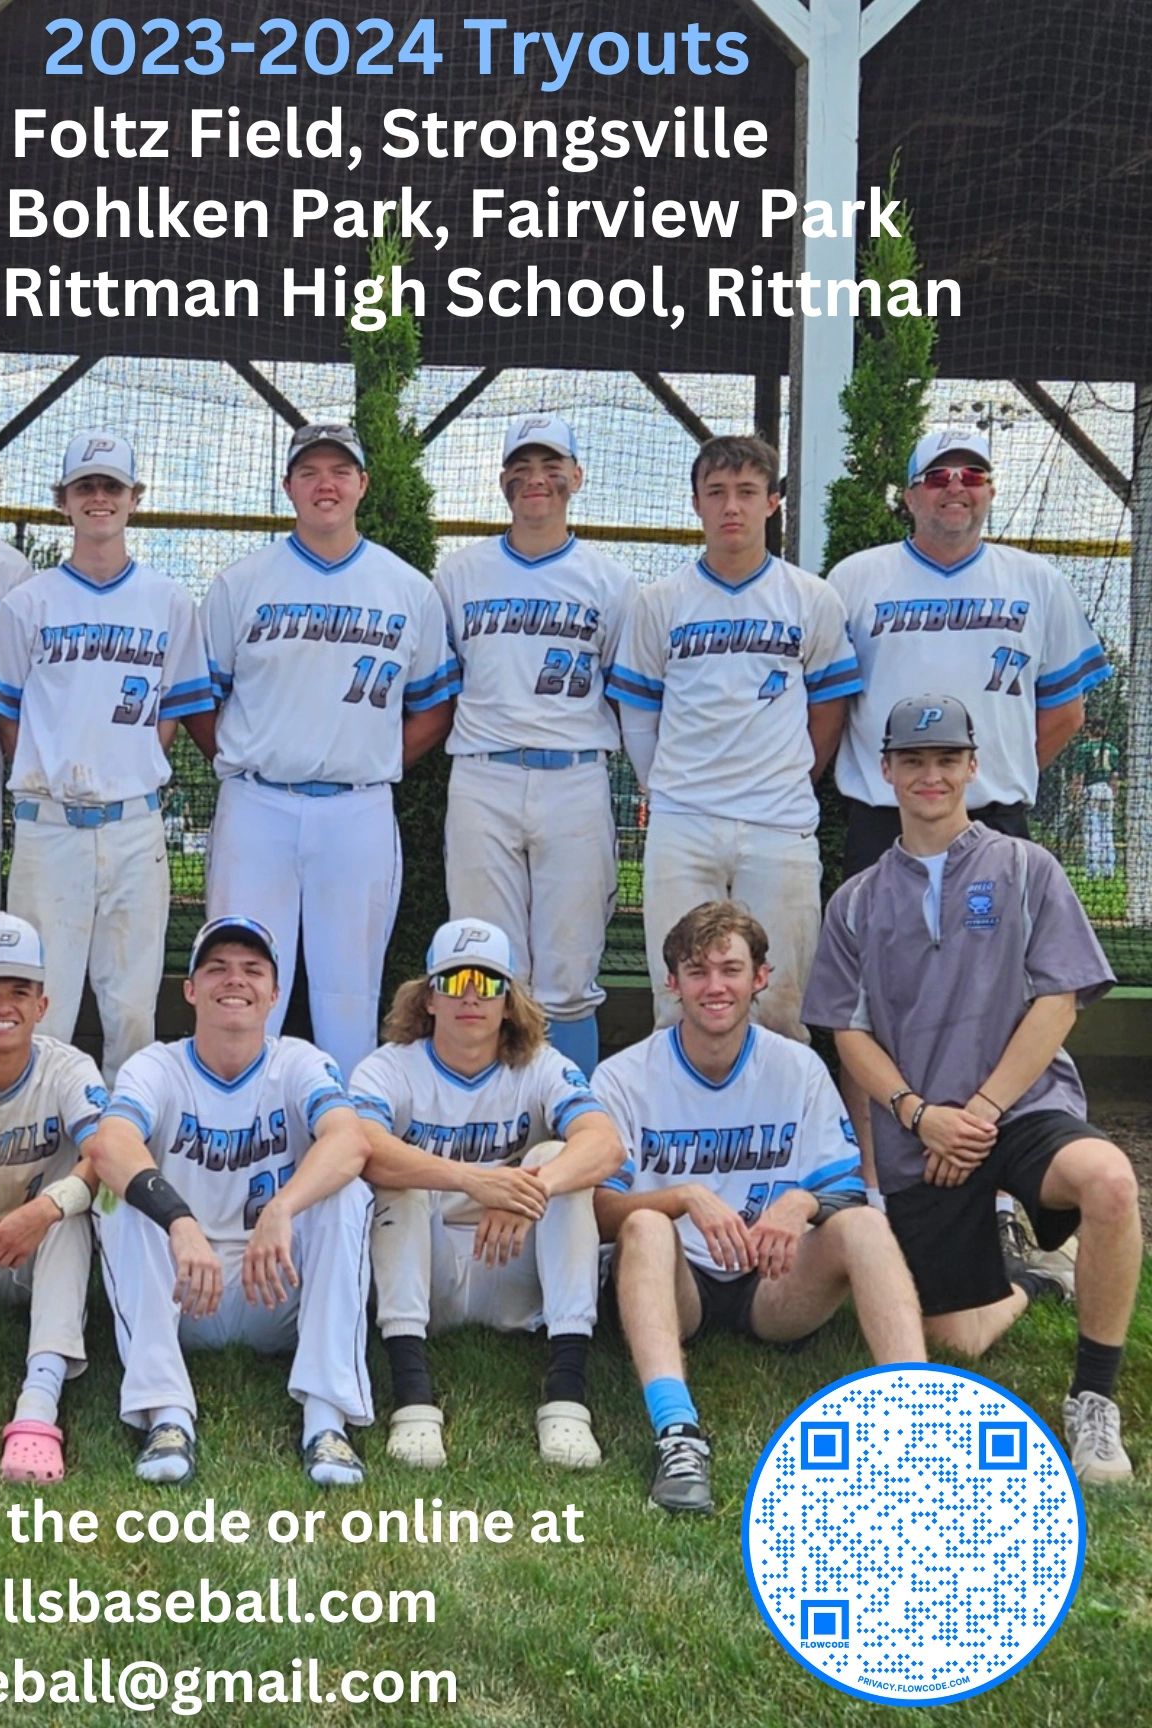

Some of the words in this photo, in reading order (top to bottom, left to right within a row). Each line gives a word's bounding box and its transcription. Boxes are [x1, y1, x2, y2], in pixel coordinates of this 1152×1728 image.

[82, 438, 116, 462] P
[517, 418, 551, 440] P
[246, 603, 407, 650] PITBULLS
[461, 597, 600, 641] PITBULLS
[668, 617, 803, 660] PITBULLS
[870, 598, 1030, 637] PITBULLS
[37, 623, 169, 667] PITBULLS
[984, 645, 1031, 697] 17
[914, 707, 944, 731] P
[453, 927, 491, 953] P
[641, 1121, 797, 1175] PITBULLS
